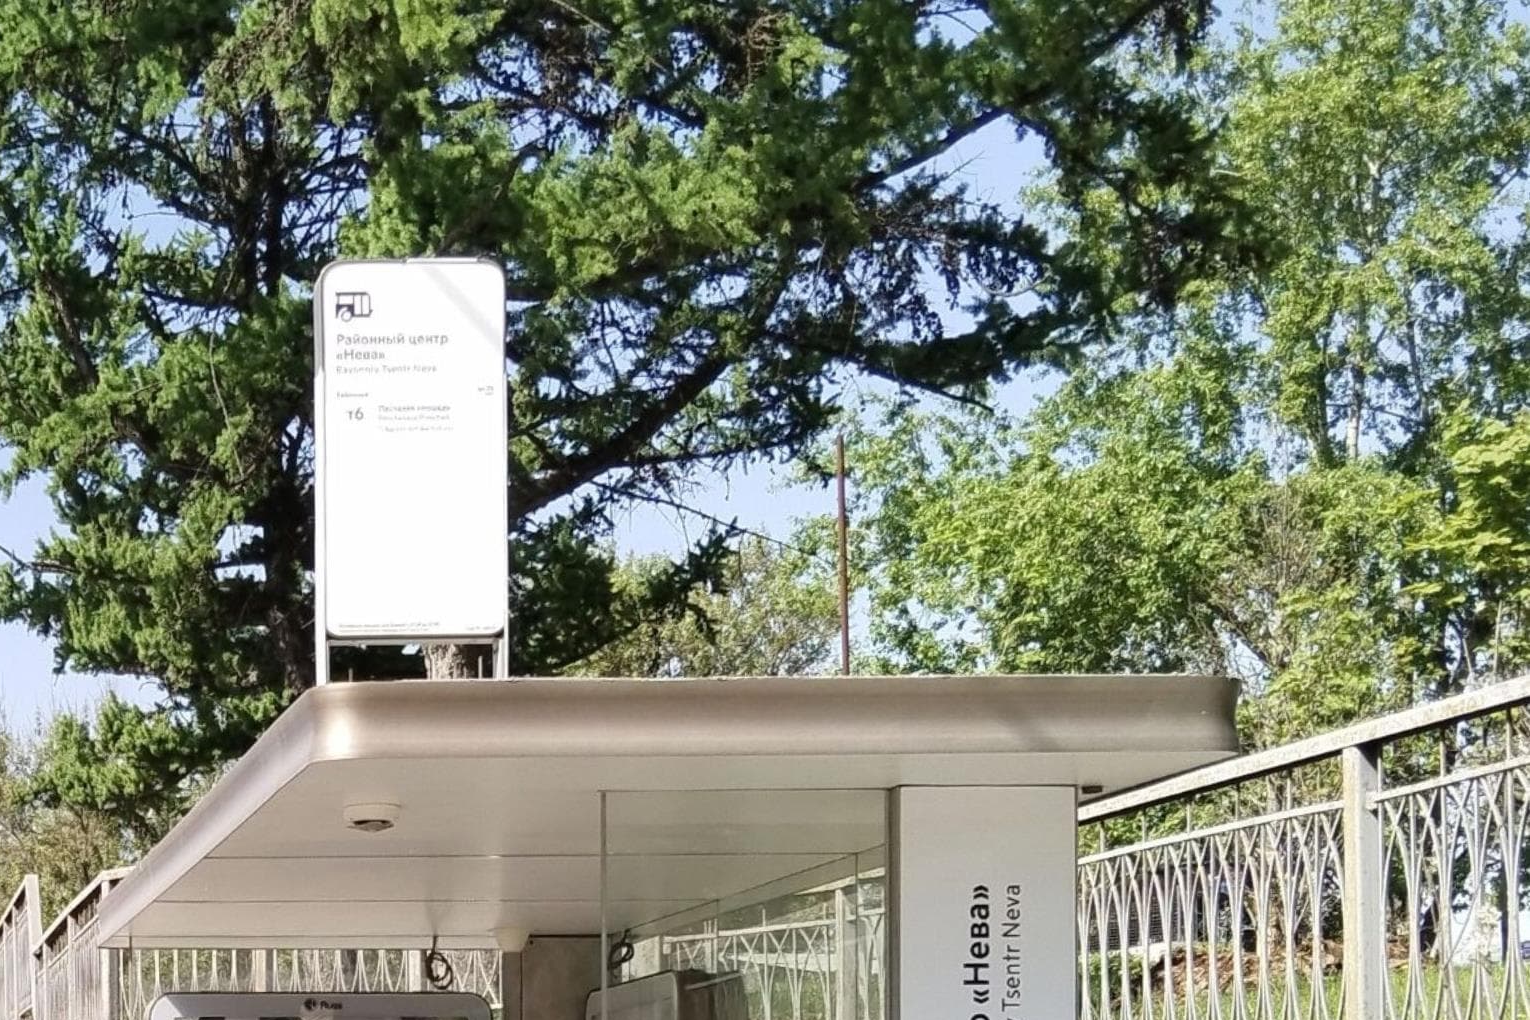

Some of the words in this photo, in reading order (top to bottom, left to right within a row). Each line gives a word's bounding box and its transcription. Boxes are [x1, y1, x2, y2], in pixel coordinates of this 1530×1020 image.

[337, 333, 405, 346] Районный
[409, 335, 449, 347] центр
[1001, 884, 1021, 937] Neva
[963, 884, 990, 1004] «Нева»
[1001, 945, 1021, 1012] Tsentr
